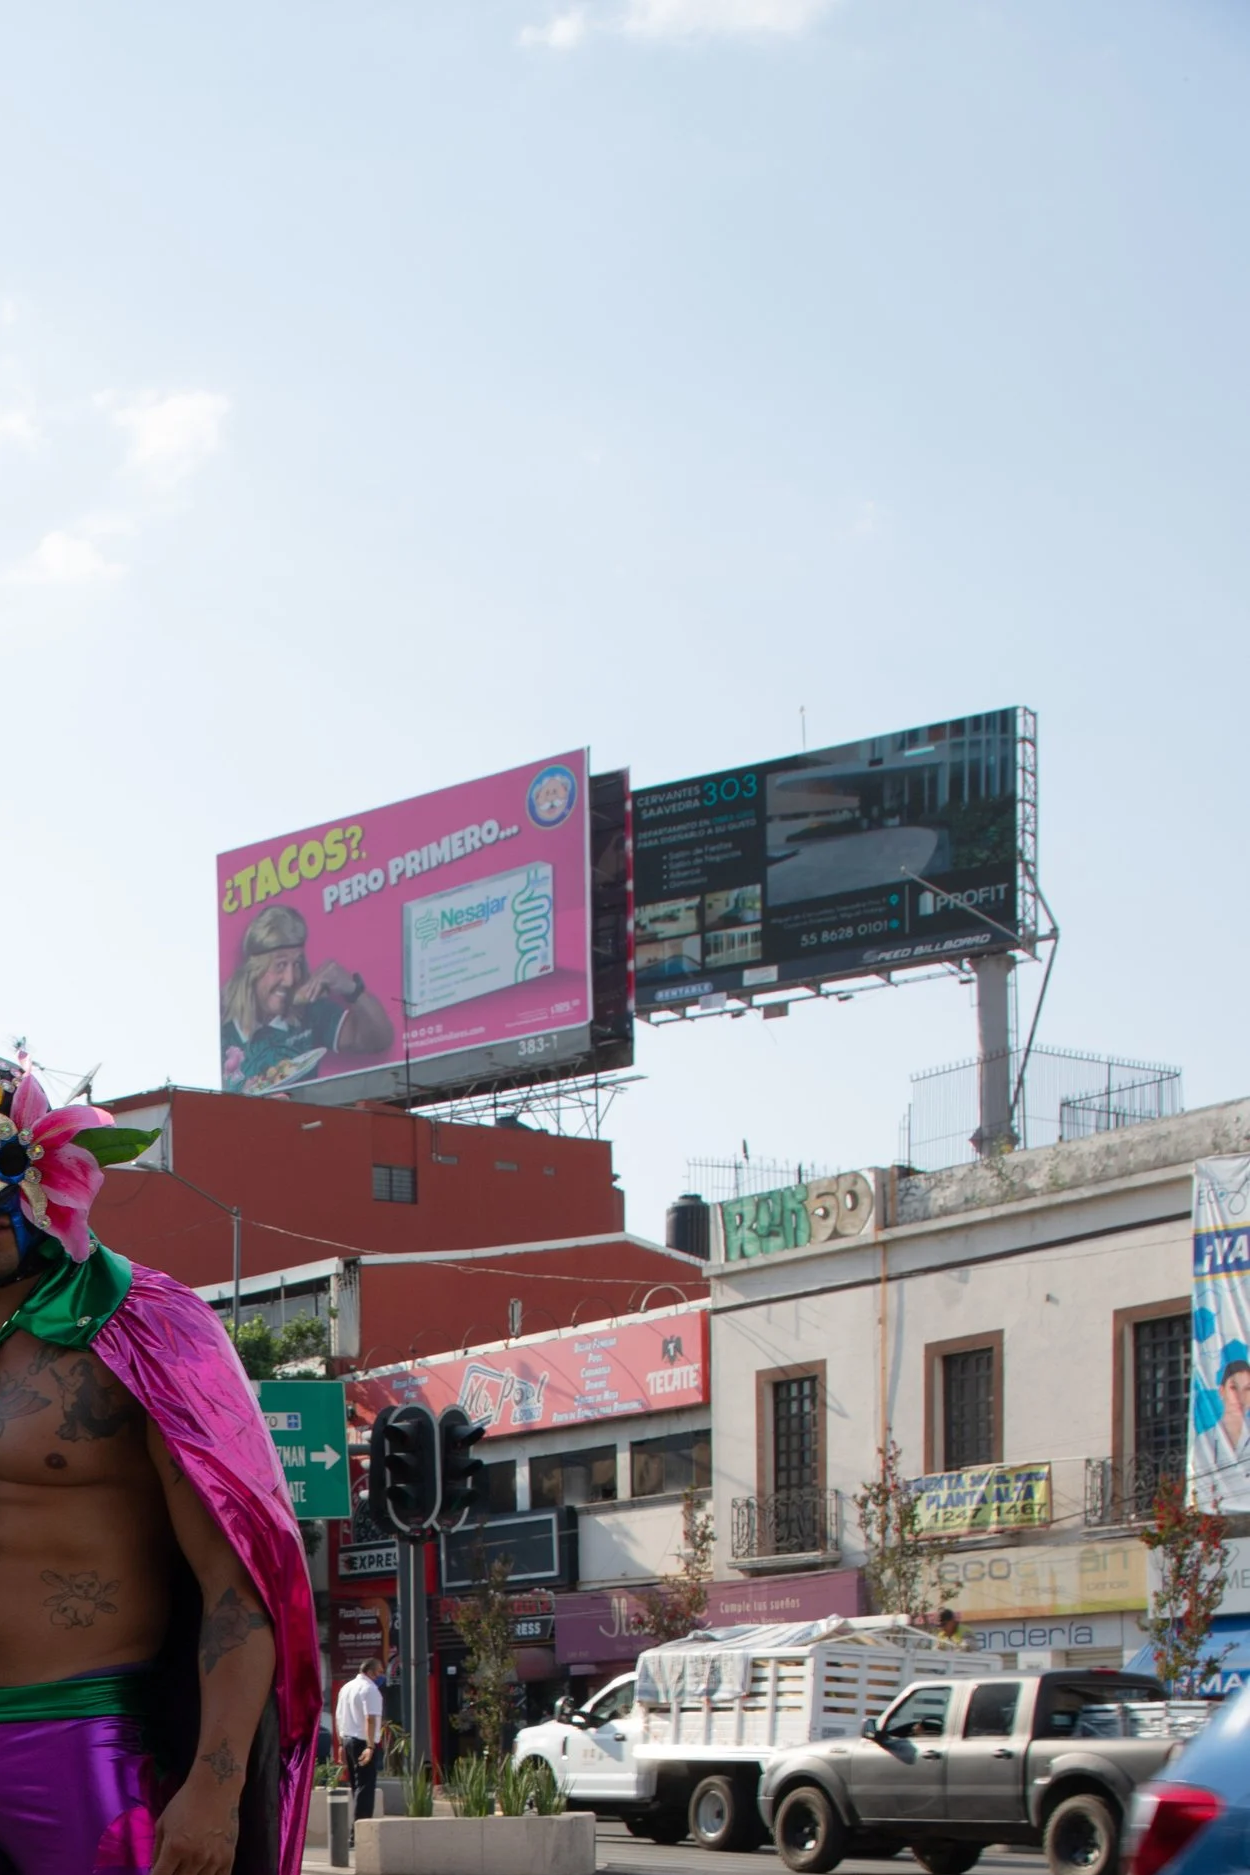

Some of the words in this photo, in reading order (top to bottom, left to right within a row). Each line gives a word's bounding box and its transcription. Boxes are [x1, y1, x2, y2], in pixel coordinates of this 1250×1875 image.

[702, 773, 758, 807] 303
[641, 798, 701, 820] SAAVEDRA
[222, 825, 364, 914] ¿TACOS?
[322, 868, 385, 913] PERO
[388, 819, 520, 886] PRIMERO...
[935, 883, 1009, 912] PROFIT
[440, 895, 508, 930] Nesajar
[800, 932, 818, 948] 55
[820, 926, 854, 943] 8628
[857, 920, 888, 935] 0101
[658, 983, 709, 998] RENTABLE
[518, 1035, 558, 1056] 383-1
[646, 1363, 700, 1396] TECATE
[264, 1415, 278, 1428] TO
[276, 1446, 306, 1467] ZMAN
[289, 1481, 307, 1502] ATE
[925, 1489, 988, 1510] PLANTA
[932, 1508, 983, 1524] 1247
[996, 1502, 1047, 1518] 1467
[352, 1551, 398, 1570] EXPRES
[720, 1599, 750, 1614] Cumple
[753, 1600, 768, 1612] tus
[769, 1597, 801, 1611] sueños
[514, 1621, 541, 1636] RESS
[978, 1621, 1094, 1649] andería
[1172, 1671, 1243, 1695] RMA
